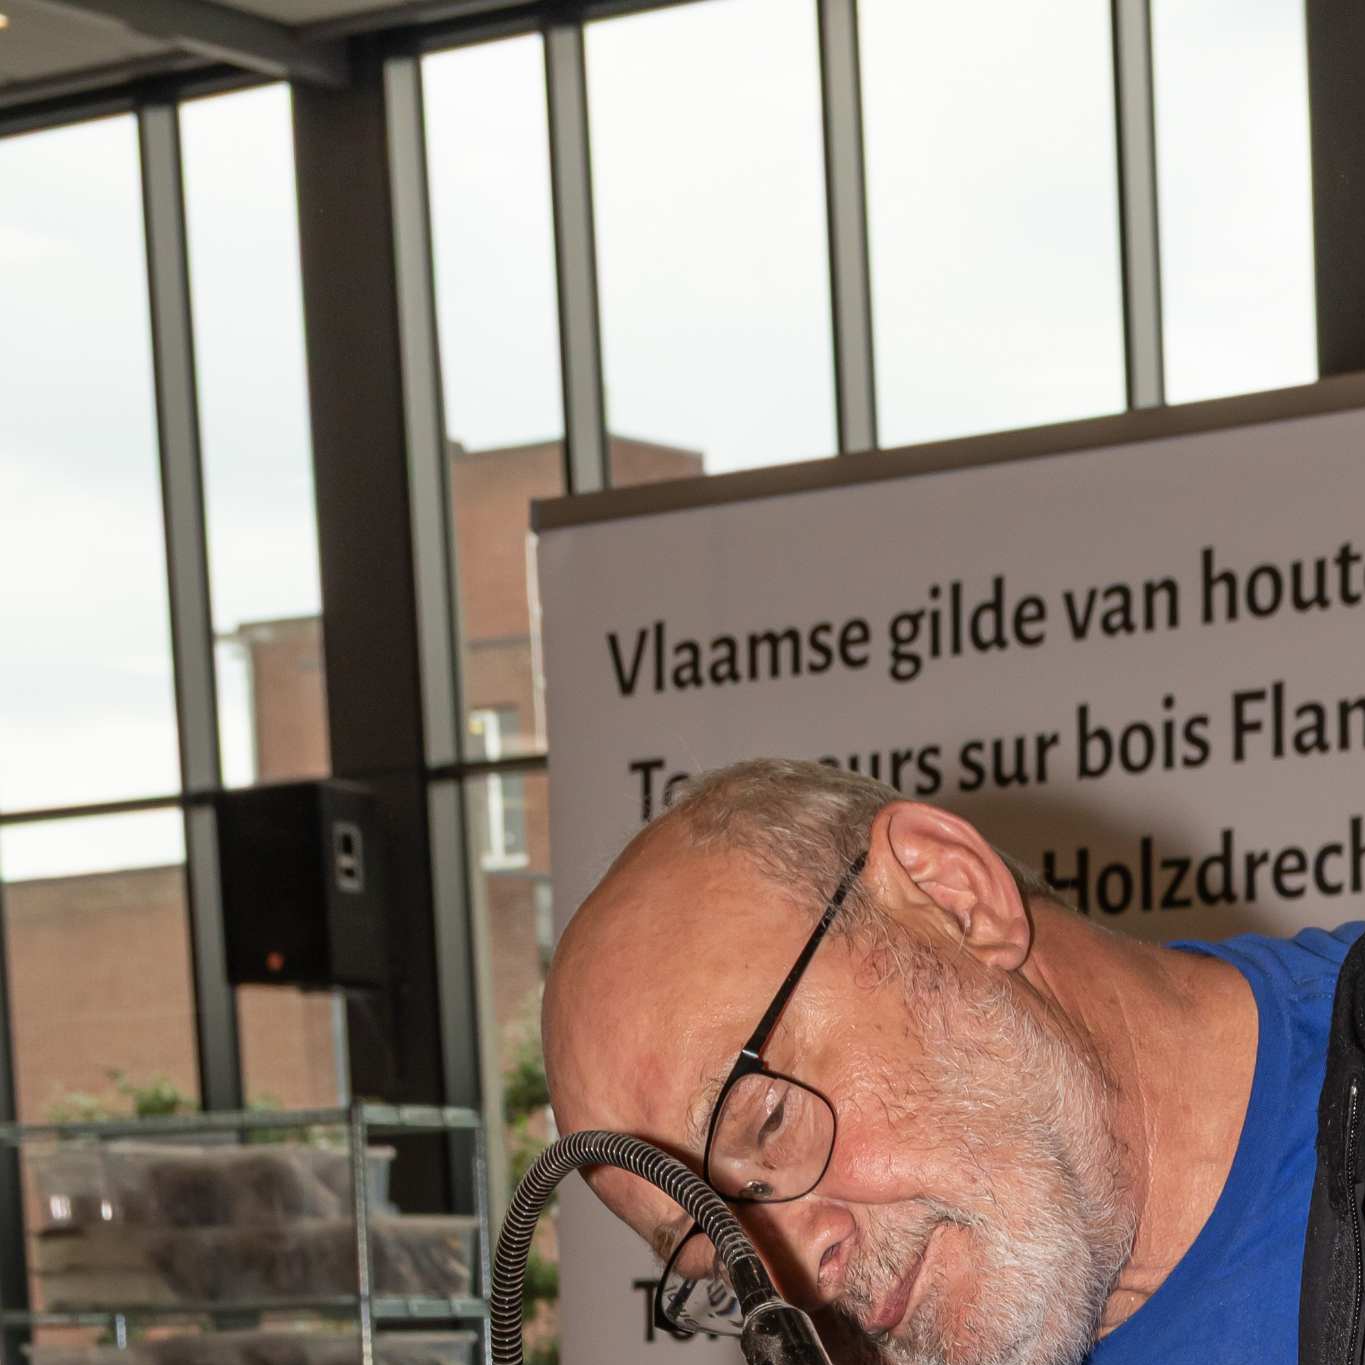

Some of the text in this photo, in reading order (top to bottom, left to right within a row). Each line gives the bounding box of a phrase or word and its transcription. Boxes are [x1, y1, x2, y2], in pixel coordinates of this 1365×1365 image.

[606, 619, 870, 697] Vlaamse
[888, 573, 1047, 683] gilde
[1063, 575, 1179, 642] van
[958, 732, 1060, 792] sur
[1077, 693, 1211, 782] bois
